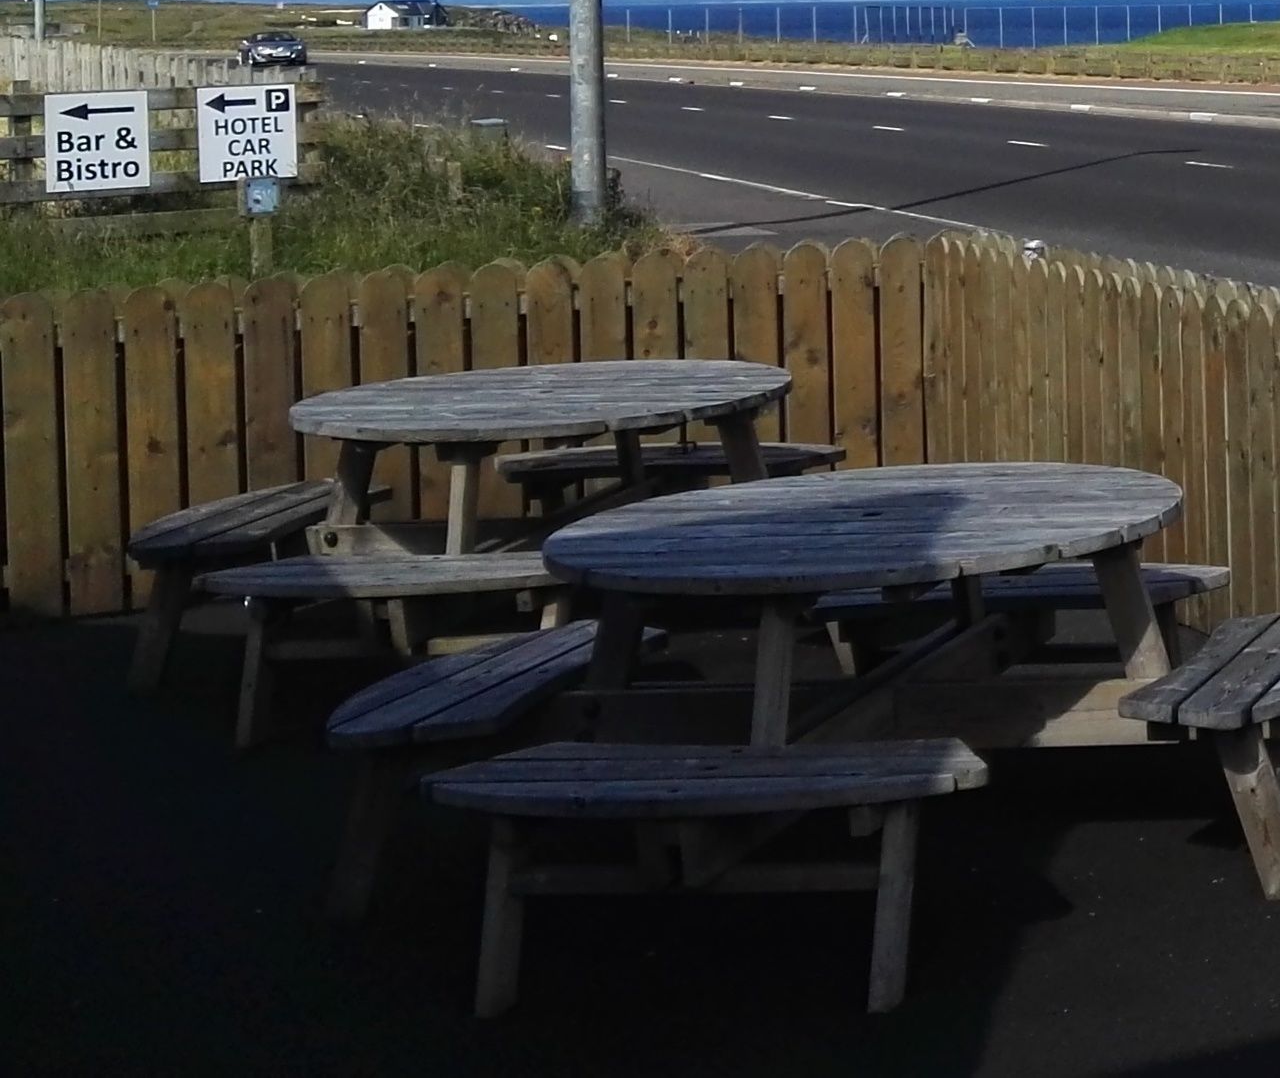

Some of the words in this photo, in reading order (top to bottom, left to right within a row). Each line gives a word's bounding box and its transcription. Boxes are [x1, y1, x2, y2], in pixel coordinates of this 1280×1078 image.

[271, 91, 285, 109] P
[214, 116, 284, 136] HOTEL
[57, 131, 105, 153] Bar
[115, 127, 138, 150] &
[228, 138, 271, 156] CAR
[56, 158, 140, 182] Bistro
[223, 159, 278, 178] PARK
